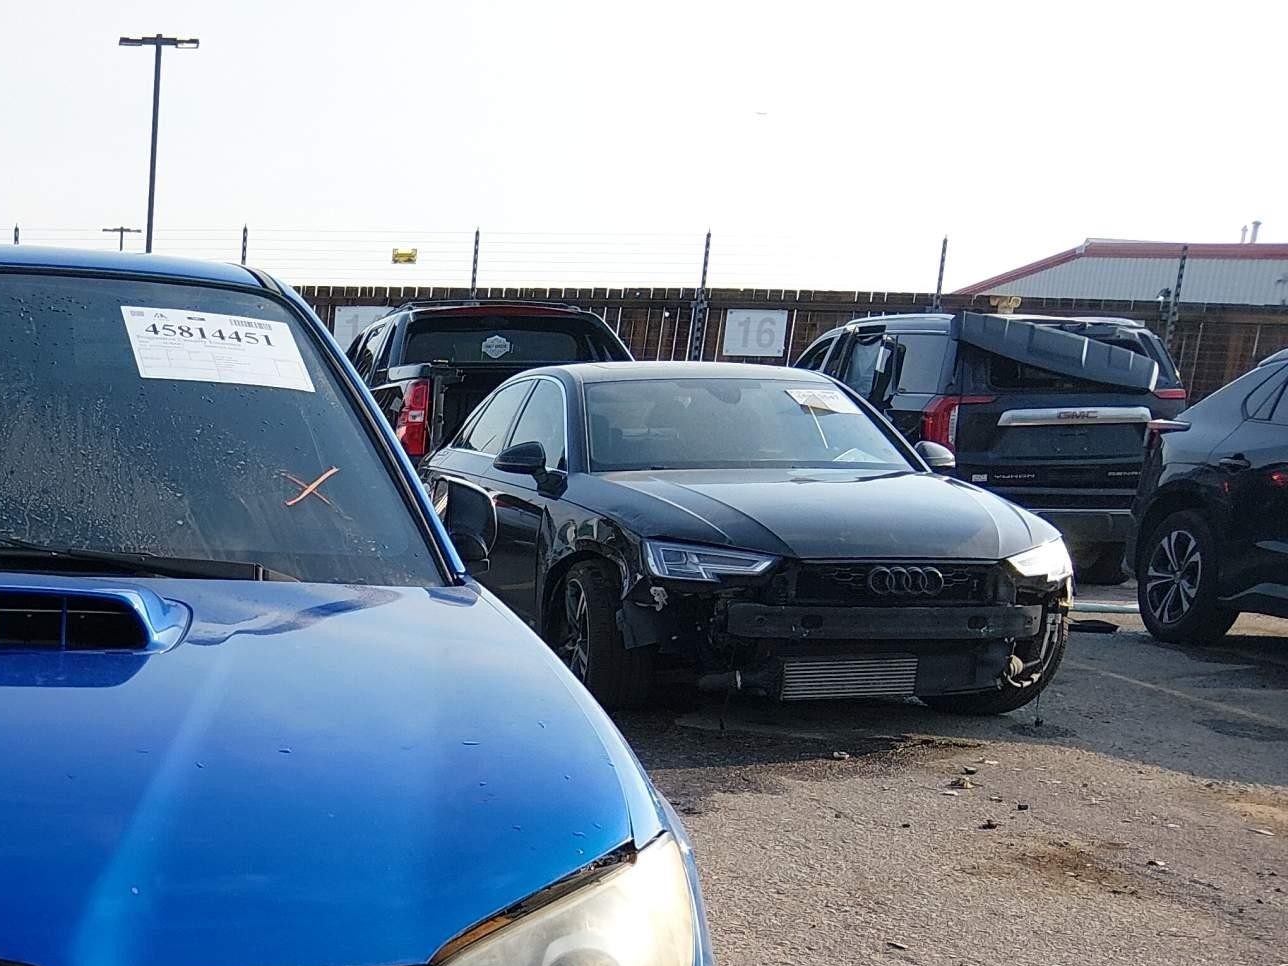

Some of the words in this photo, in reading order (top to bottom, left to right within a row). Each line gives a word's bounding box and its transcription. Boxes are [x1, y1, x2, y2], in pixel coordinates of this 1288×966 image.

[144, 323, 276, 348] 45814451
[738, 316, 776, 349] 16
[1057, 410, 1099, 420] GMC
